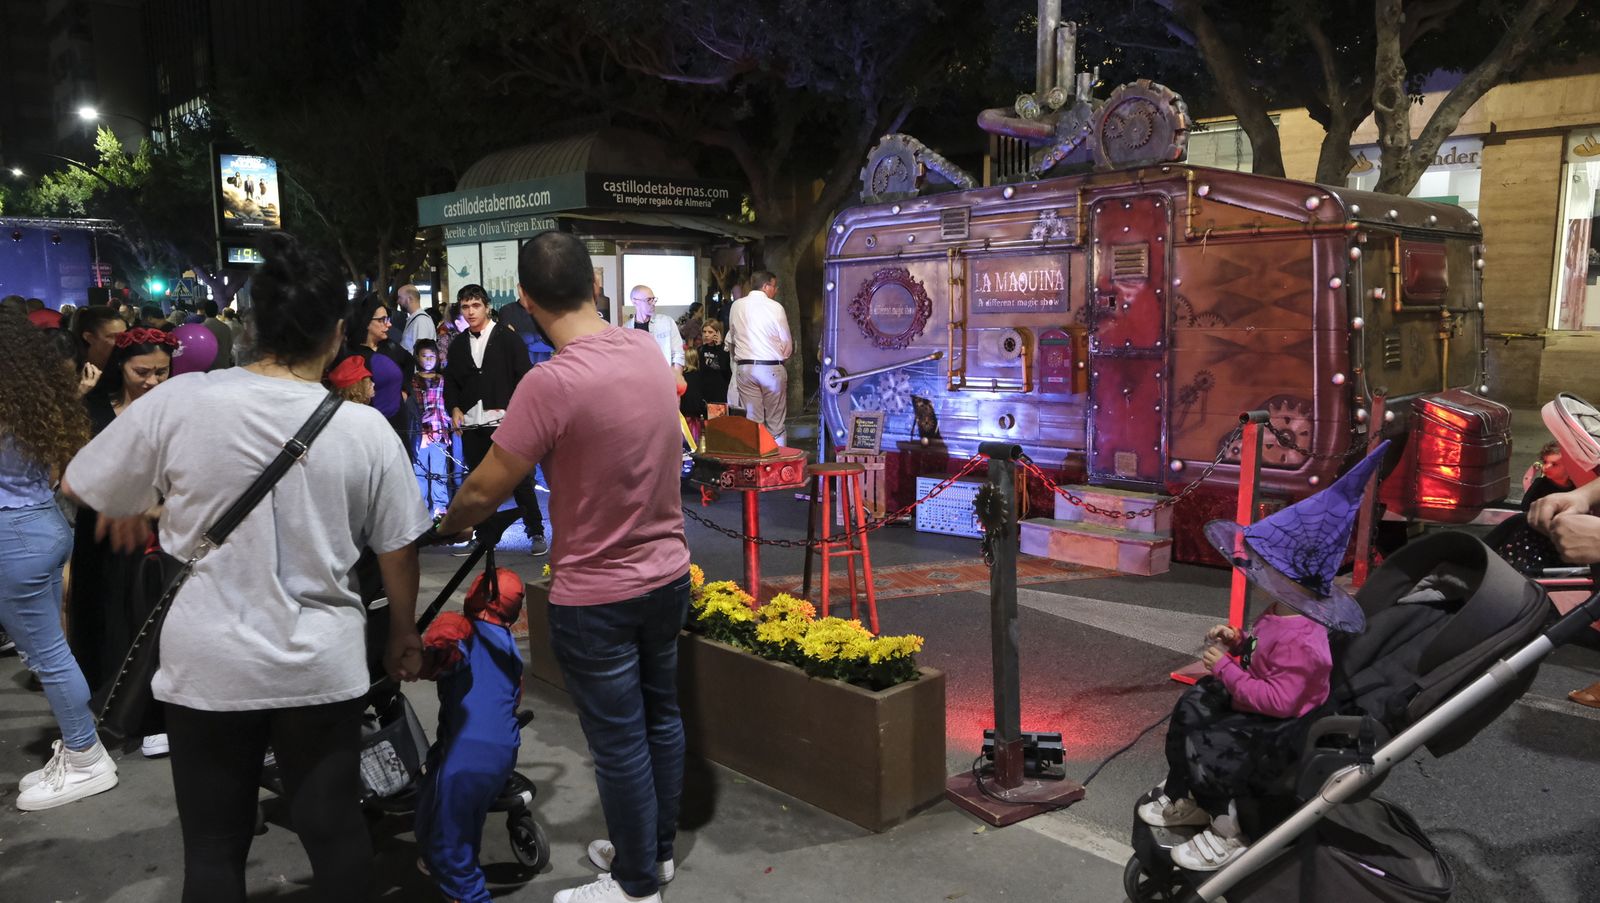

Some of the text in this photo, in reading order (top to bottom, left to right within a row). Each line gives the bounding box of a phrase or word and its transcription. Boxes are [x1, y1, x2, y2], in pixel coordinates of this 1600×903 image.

[603, 180, 729, 199] castillodetabernas.com
[443, 190, 551, 218] castillodetabernas.com
[625, 195, 648, 206] mejor
[649, 197, 673, 207] regalo
[674, 197, 684, 206] de
[444, 217, 556, 240] Aceite de Oliva Virgen Extra
[975, 269, 1065, 296] LA MAQUINA
[978, 297, 1060, 309] A different magic show
